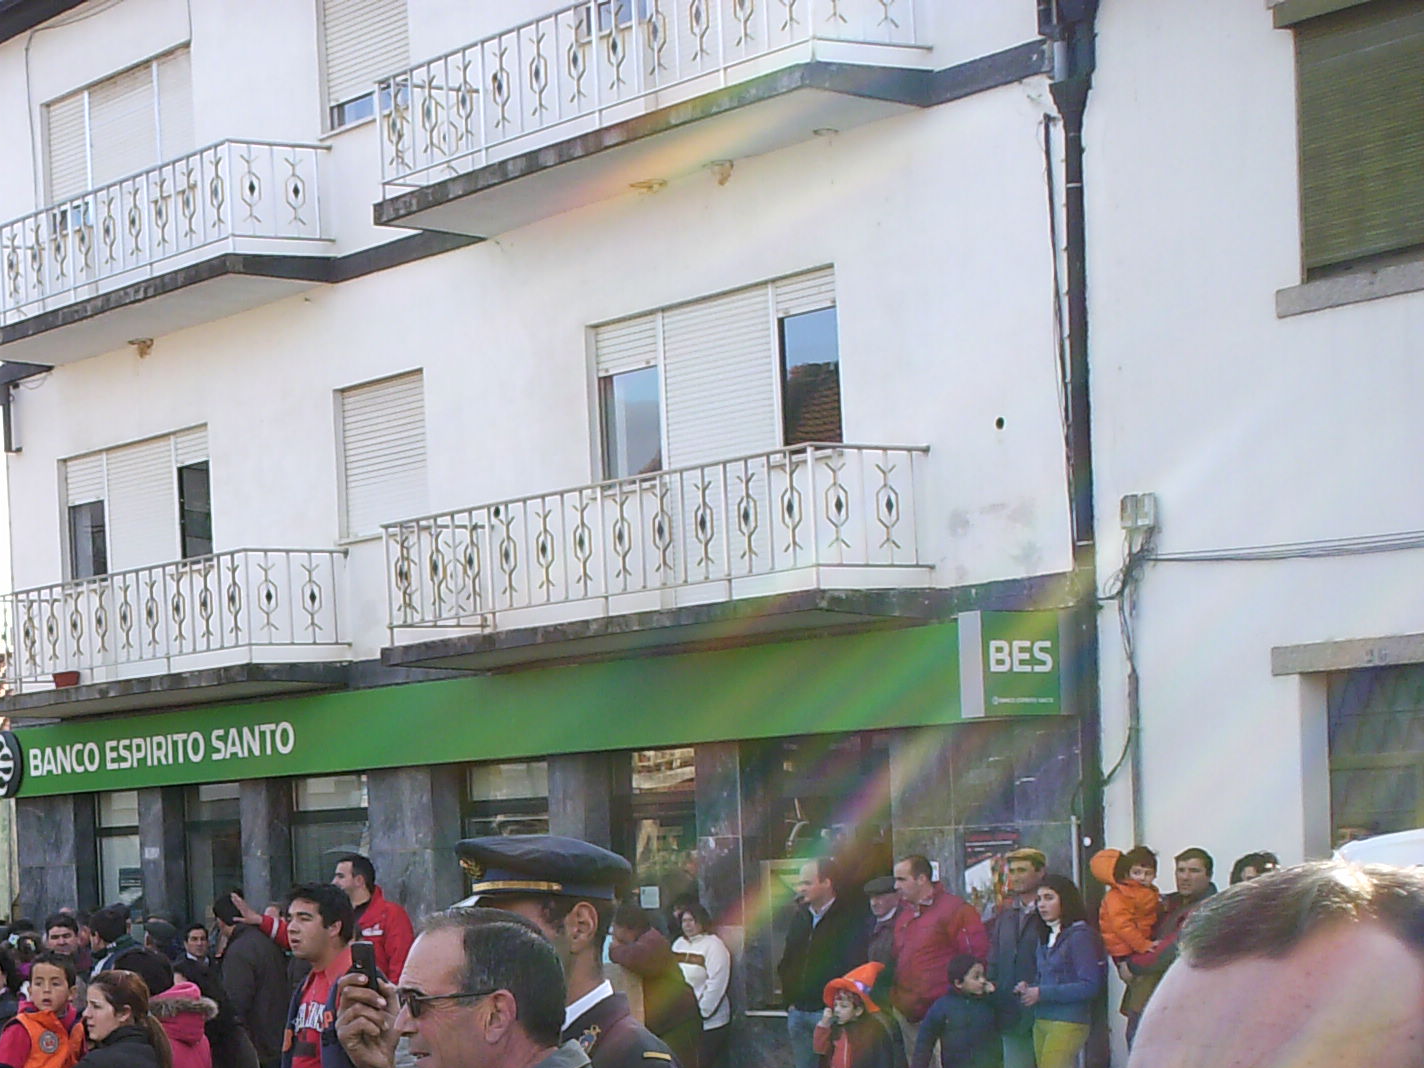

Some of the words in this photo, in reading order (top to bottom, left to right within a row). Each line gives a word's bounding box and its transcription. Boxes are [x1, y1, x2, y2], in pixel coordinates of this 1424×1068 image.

[989, 640, 1053, 672] BES
[29, 742, 100, 777] BANCO
[105, 731, 205, 771] ESPIRITO
[211, 721, 295, 761] SANTO
